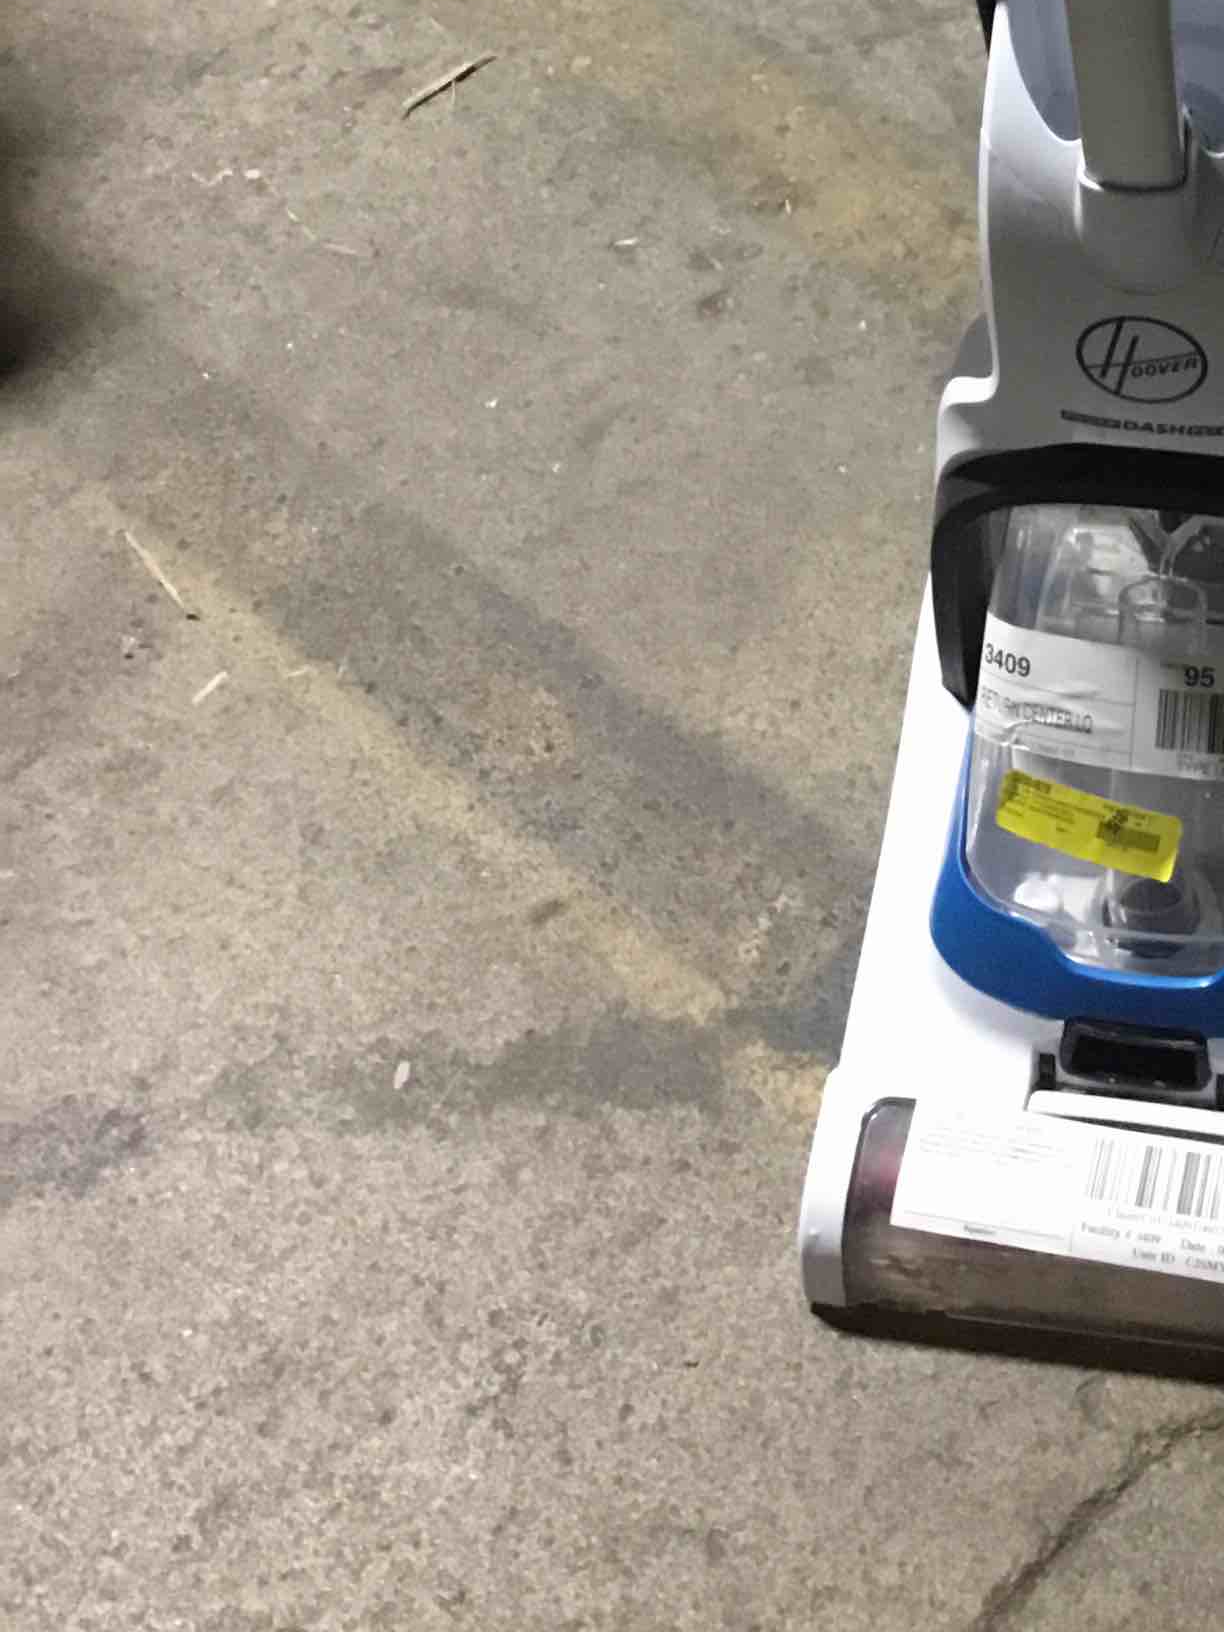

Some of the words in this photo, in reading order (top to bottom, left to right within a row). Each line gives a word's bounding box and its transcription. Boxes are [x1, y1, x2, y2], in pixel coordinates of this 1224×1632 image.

[1099, 319, 1200, 396] HOOVER
[984, 642, 1032, 678] 3409
[1183, 665, 1215, 688] 95
